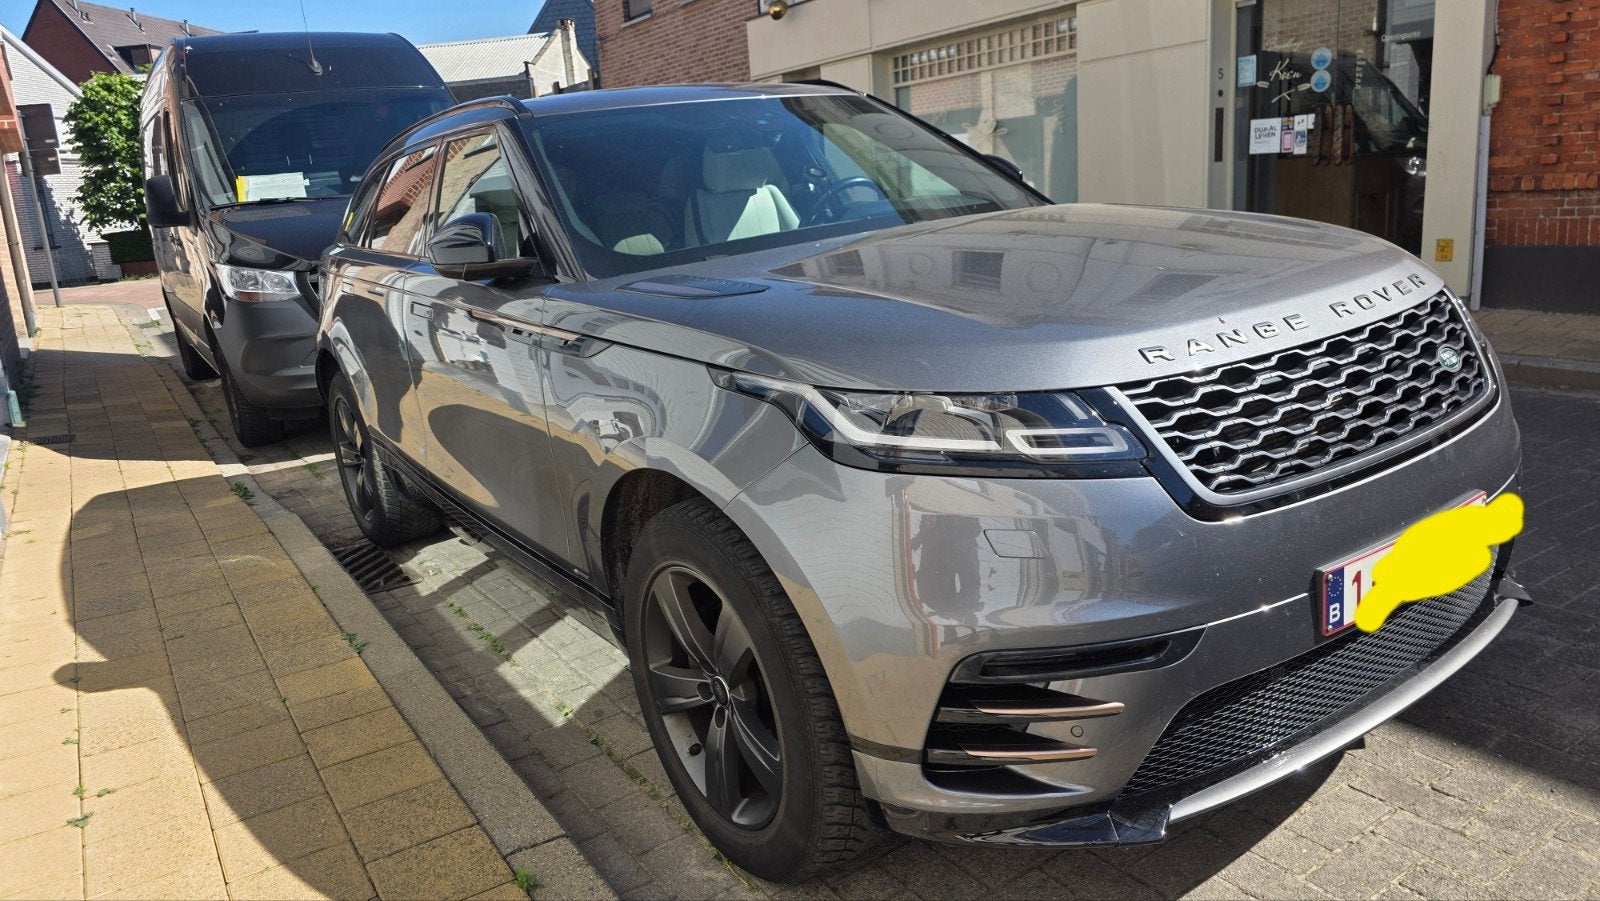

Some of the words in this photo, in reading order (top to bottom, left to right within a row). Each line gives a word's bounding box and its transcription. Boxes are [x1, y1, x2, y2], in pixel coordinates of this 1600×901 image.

[1217, 67, 1224, 80] 5
[1138, 313, 1310, 364] RANGE
[1329, 273, 1426, 317] ROVER
[1329, 603, 1341, 623] B
